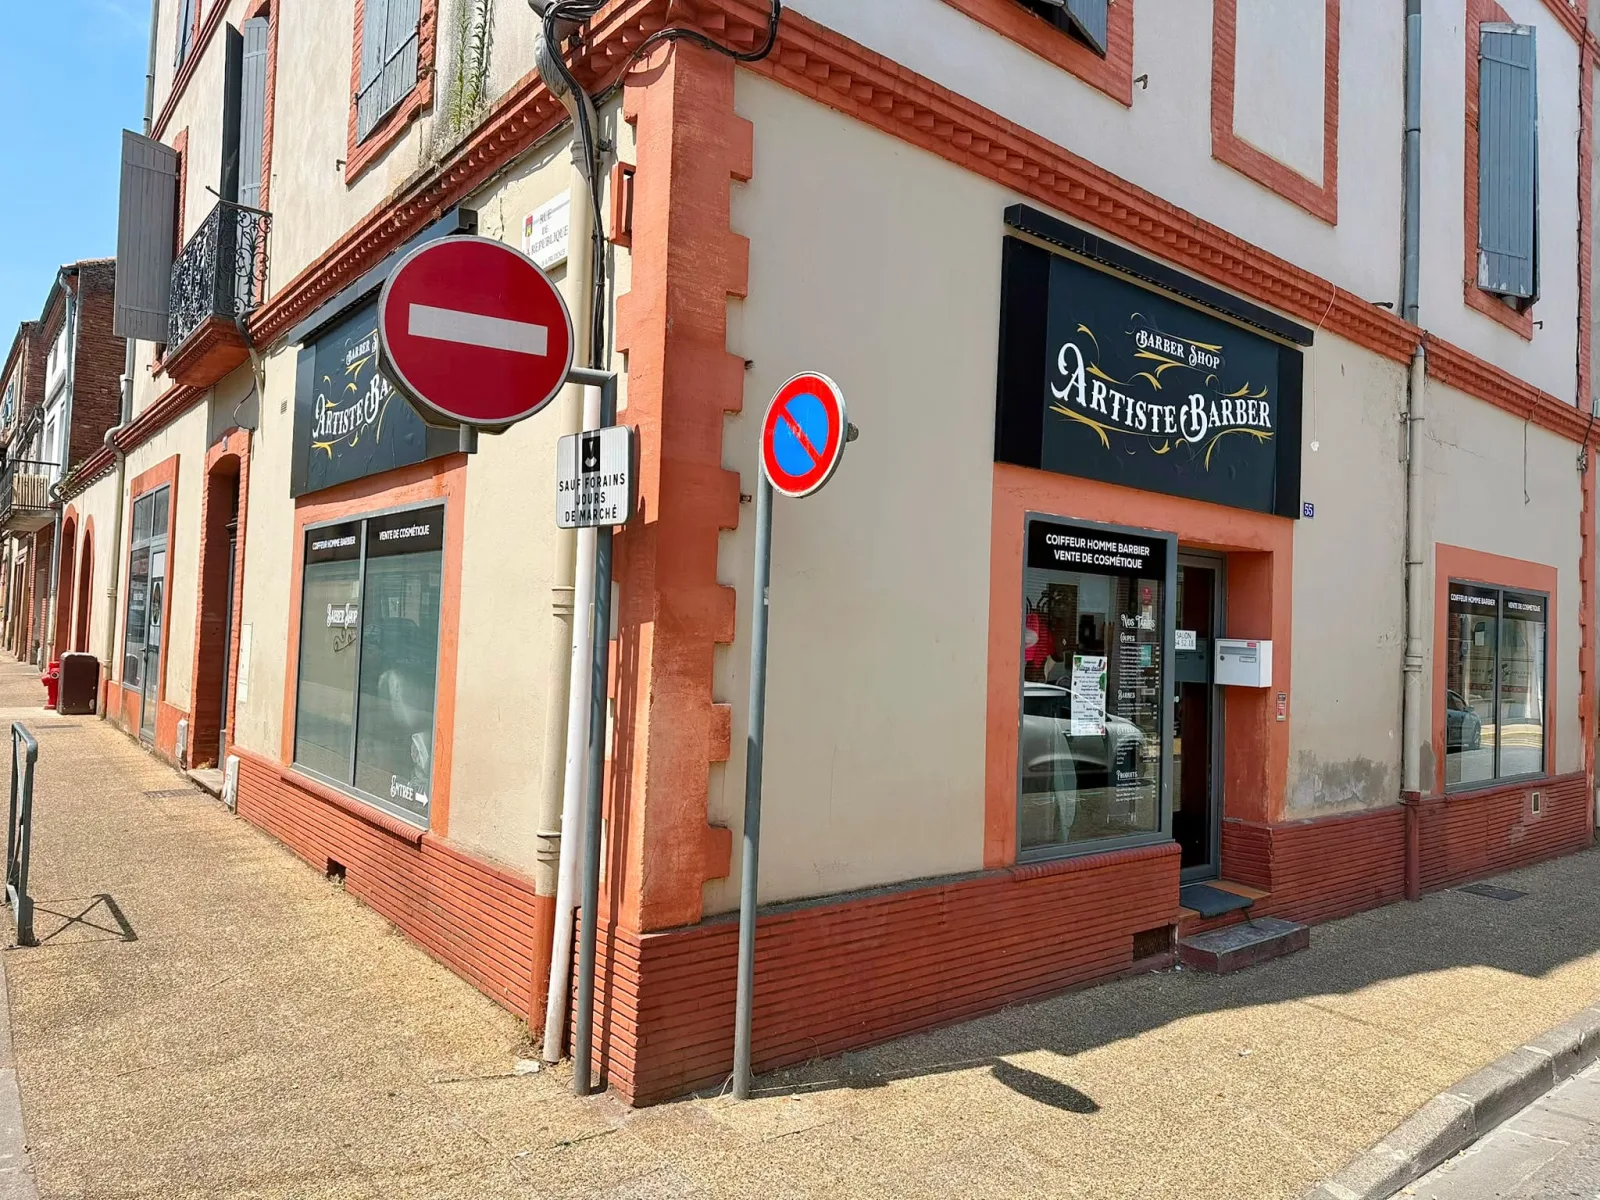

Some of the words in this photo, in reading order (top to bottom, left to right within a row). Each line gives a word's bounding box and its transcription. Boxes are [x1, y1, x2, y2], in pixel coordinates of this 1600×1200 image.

[346, 340, 370, 365] BARBER
[1135, 330, 1184, 358] BARBER
[1188, 345, 1220, 369] SHOP
[1050, 342, 1178, 433] ARTISTE
[1180, 393, 1271, 443] BARBER
[312, 393, 364, 439] ARTISTE
[559, 478, 581, 492] SAUF
[584, 473, 626, 489] FORAINS
[575, 491, 606, 506] JOURS
[565, 511, 576, 523] DE
[579, 504, 617, 521] MARCHÉ
[1304, 503, 1313, 517] 55
[379, 530, 393, 541] VENTE
[393, 528, 399, 539] DE
[399, 524, 430, 538] COSMÉTIQUE
[1045, 534, 1086, 548] COIFFEUR
[1087, 539, 1117, 552] HOMME
[1118, 544, 1150, 556] BARBIER
[1054, 550, 1081, 562] VENTE
[1082, 553, 1093, 564] DE
[1094, 554, 1143, 569] COSMÉTIQUE
[1120, 613, 1135, 628] NOS
[1176, 631, 1192, 640] SALON
[390, 774, 414, 802] ENTRÉE
